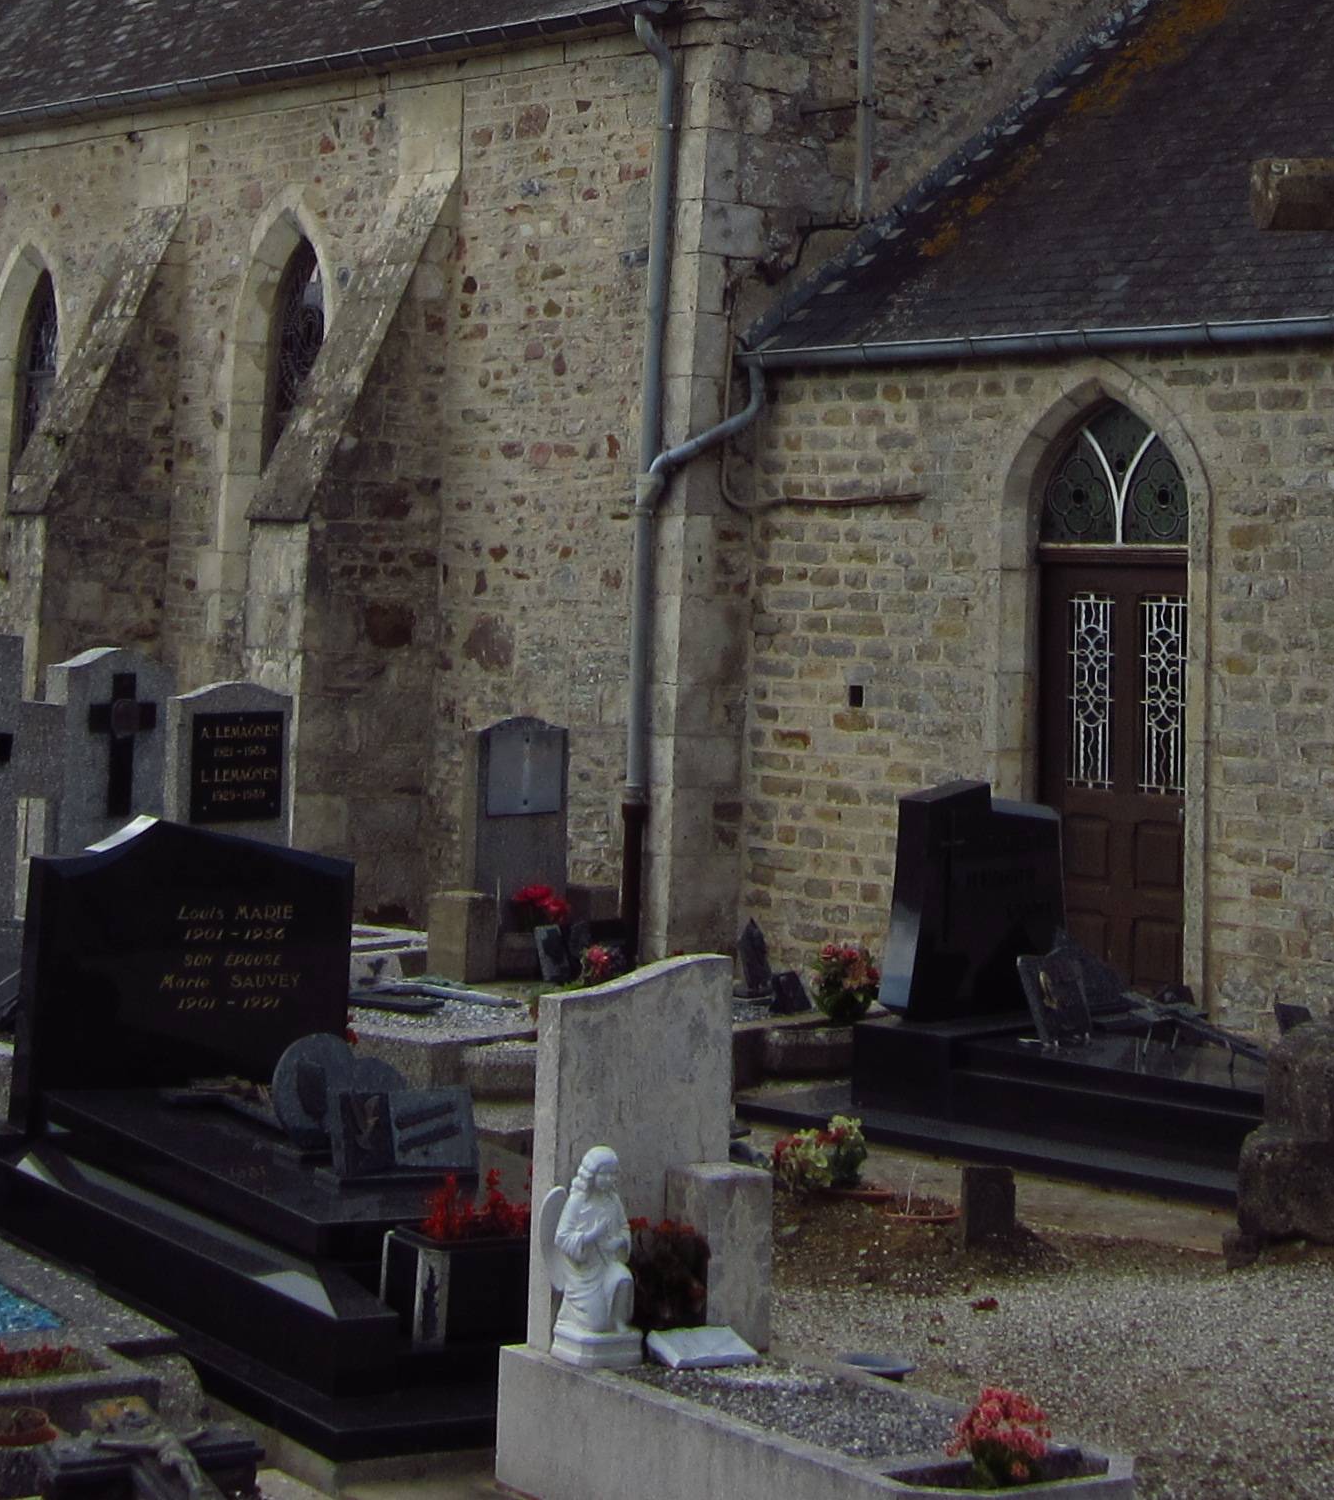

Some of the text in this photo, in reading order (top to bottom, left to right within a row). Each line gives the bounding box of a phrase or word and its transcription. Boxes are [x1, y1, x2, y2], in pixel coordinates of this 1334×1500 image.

[177, 905, 225, 921] Louis
[159, 972, 301, 989] Marie SAUVEY
